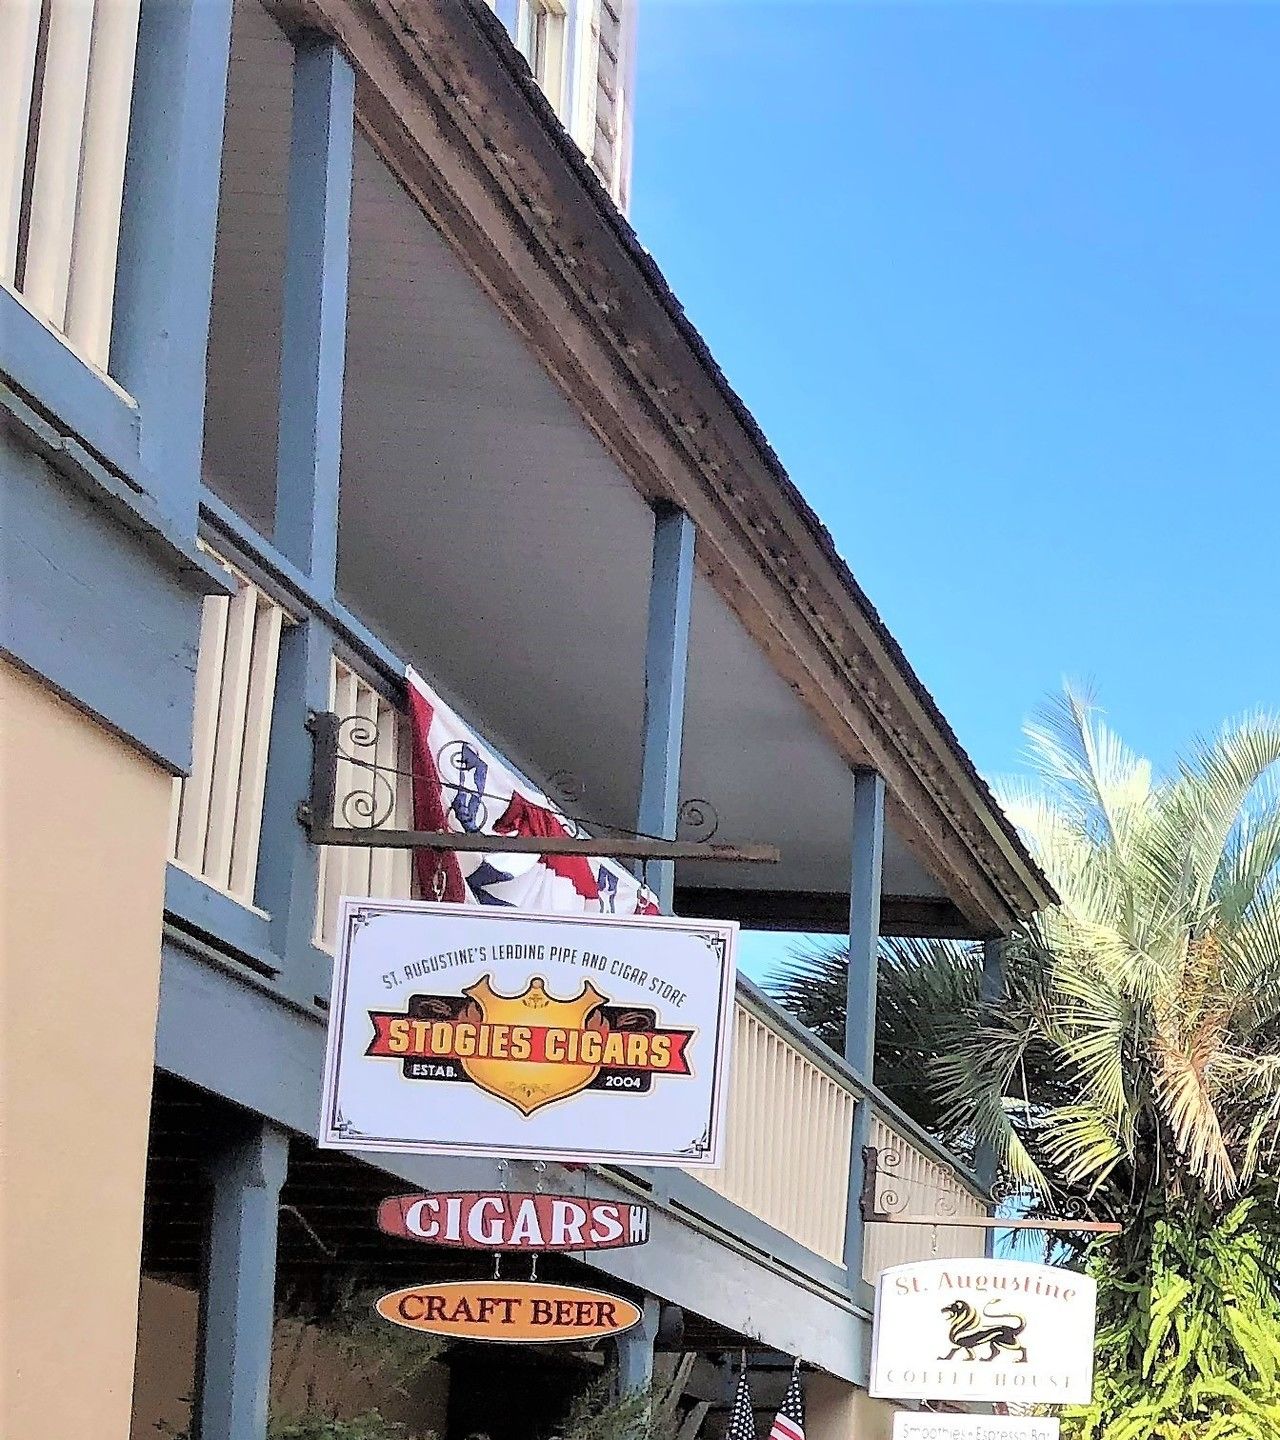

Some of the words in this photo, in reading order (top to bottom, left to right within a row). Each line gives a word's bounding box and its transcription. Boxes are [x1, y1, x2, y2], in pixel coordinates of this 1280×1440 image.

[382, 971, 402, 989] ST.
[404, 947, 487, 980] AUGUSTINE'S
[492, 944, 545, 960] LEADING
[550, 946, 577, 965] PIPE
[582, 951, 608, 971] AND
[610, 960, 648, 986] CIGAR
[648, 977, 687, 1008] STORE
[389, 1020, 531, 1059] STOGIES
[545, 1028, 671, 1067] CIGARS
[413, 1064, 458, 1078] ESTAB.
[605, 1075, 641, 1088] 2004
[405, 1197, 624, 1246] CIGARS
[895, 1275, 929, 1297] St.
[938, 1272, 1077, 1302] Augustine
[398, 1294, 522, 1324] CRAFT
[530, 1300, 619, 1327] BEER
